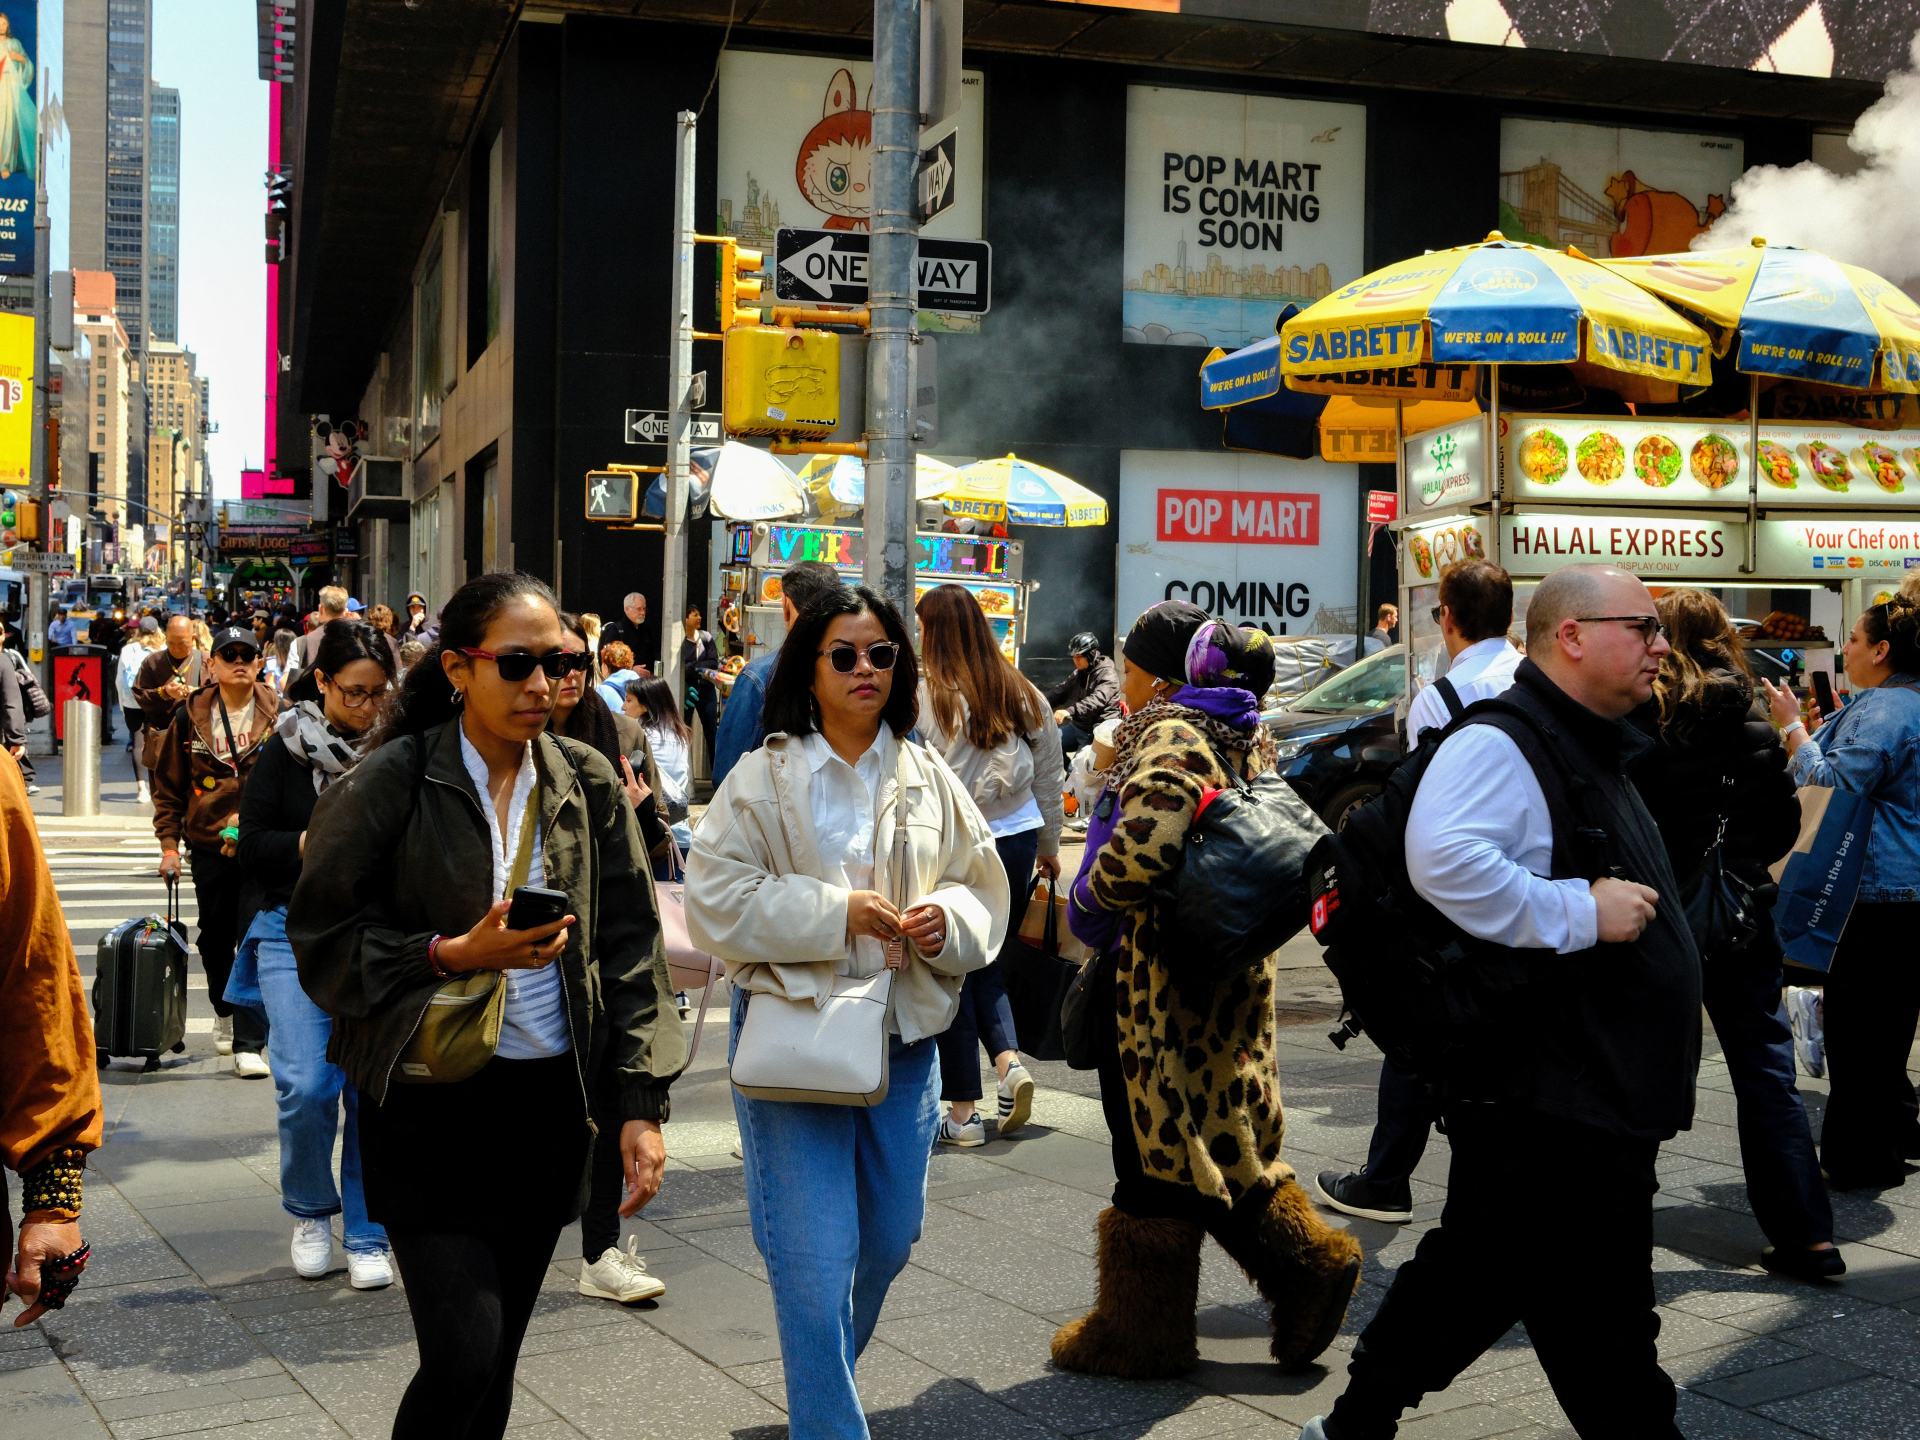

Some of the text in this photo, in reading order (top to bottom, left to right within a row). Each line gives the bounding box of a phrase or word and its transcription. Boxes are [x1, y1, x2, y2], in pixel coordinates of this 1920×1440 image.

[928, 161, 946, 197] WAY
[1164, 152, 1321, 192] POP MART
[1164, 184, 1320, 223] IS COMING
[1198, 218, 1283, 251] SOON
[805, 252, 868, 283] ONE
[1287, 321, 1422, 364] SABRETT
[1444, 332, 1566, 344] WE'RE ON A ROLL !!!
[1593, 323, 1703, 373] SABRETT
[1751, 343, 1863, 369] WE'RE ON A ROLL !!!
[1209, 379, 1234, 393] WE'RE
[1235, 376, 1245, 388] ON
[1246, 374, 1251, 385] A
[1253, 369, 1268, 383] ROLL
[642, 421, 669, 434] ONE
[1822, 432, 1841, 440] GYRO
[1422, 480, 1441, 496] HALAL
[1069, 507, 1103, 521] SABRETT
[1164, 497, 1312, 538] POP MART
[219, 534, 248, 549] GIFTS
[1512, 526, 1724, 558] HALAL EXPRESS
[1805, 528, 1844, 549] Your
[1848, 528, 1885, 549] Chef
[1889, 533, 1909, 550] on
[1616, 561, 1680, 571] DISPLAY ONLY
[1164, 580, 1310, 617] COMING
[229, 627, 241, 637] LA
[1807, 831, 1855, 928] fun's in the bag
